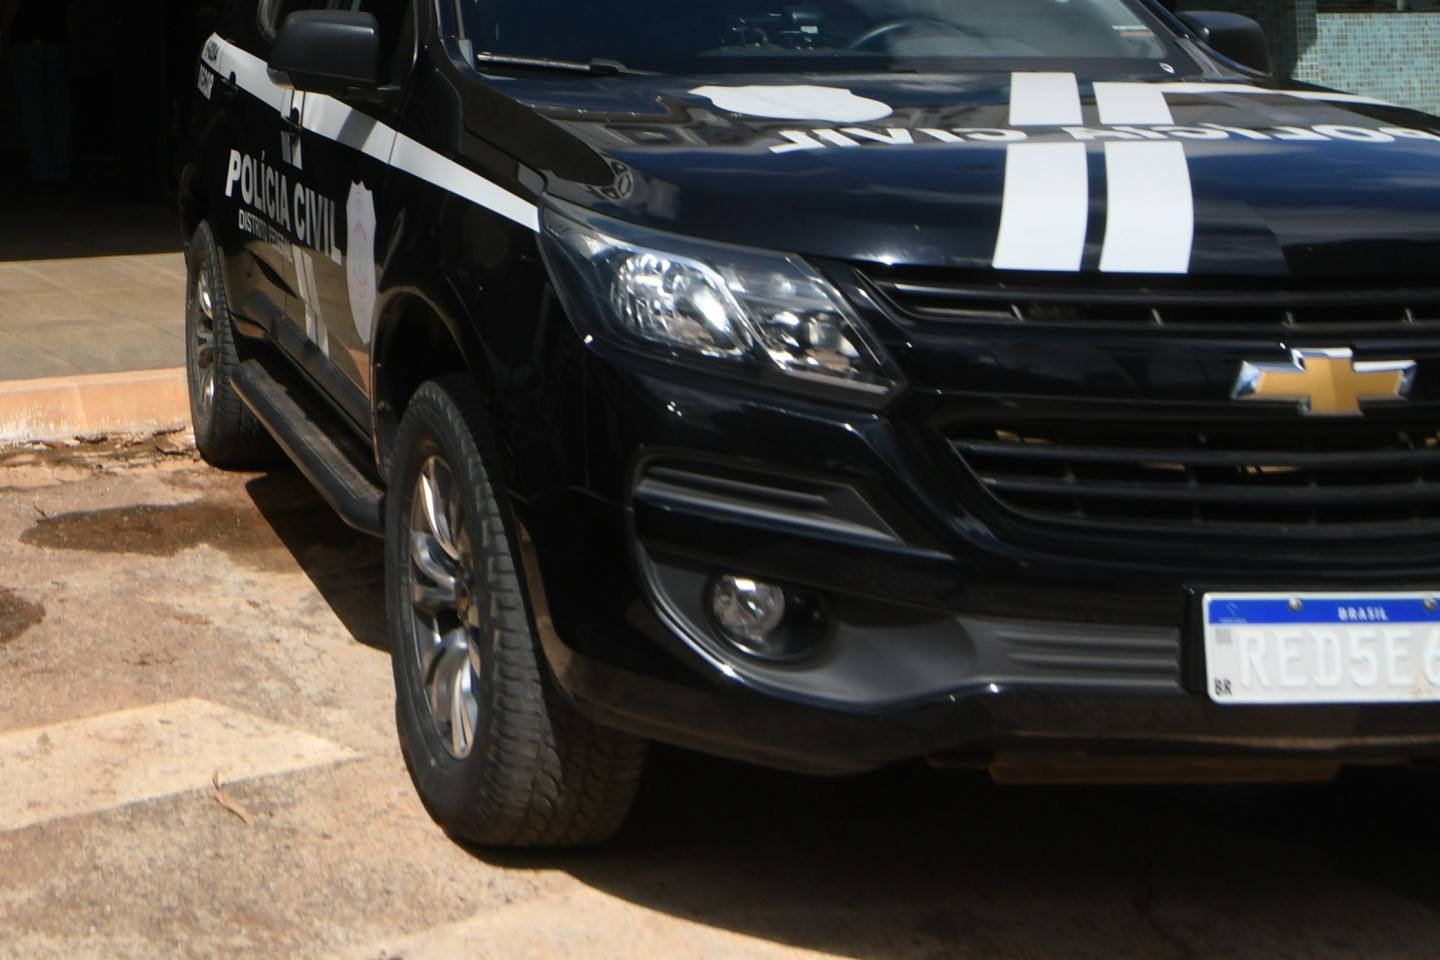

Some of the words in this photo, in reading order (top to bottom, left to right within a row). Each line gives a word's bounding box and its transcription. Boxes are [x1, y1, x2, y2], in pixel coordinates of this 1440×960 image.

[225, 149, 291, 232] POLÍCIA
[293, 182, 342, 266] CIVIL
[1337, 606, 1389, 622] BRASIL
